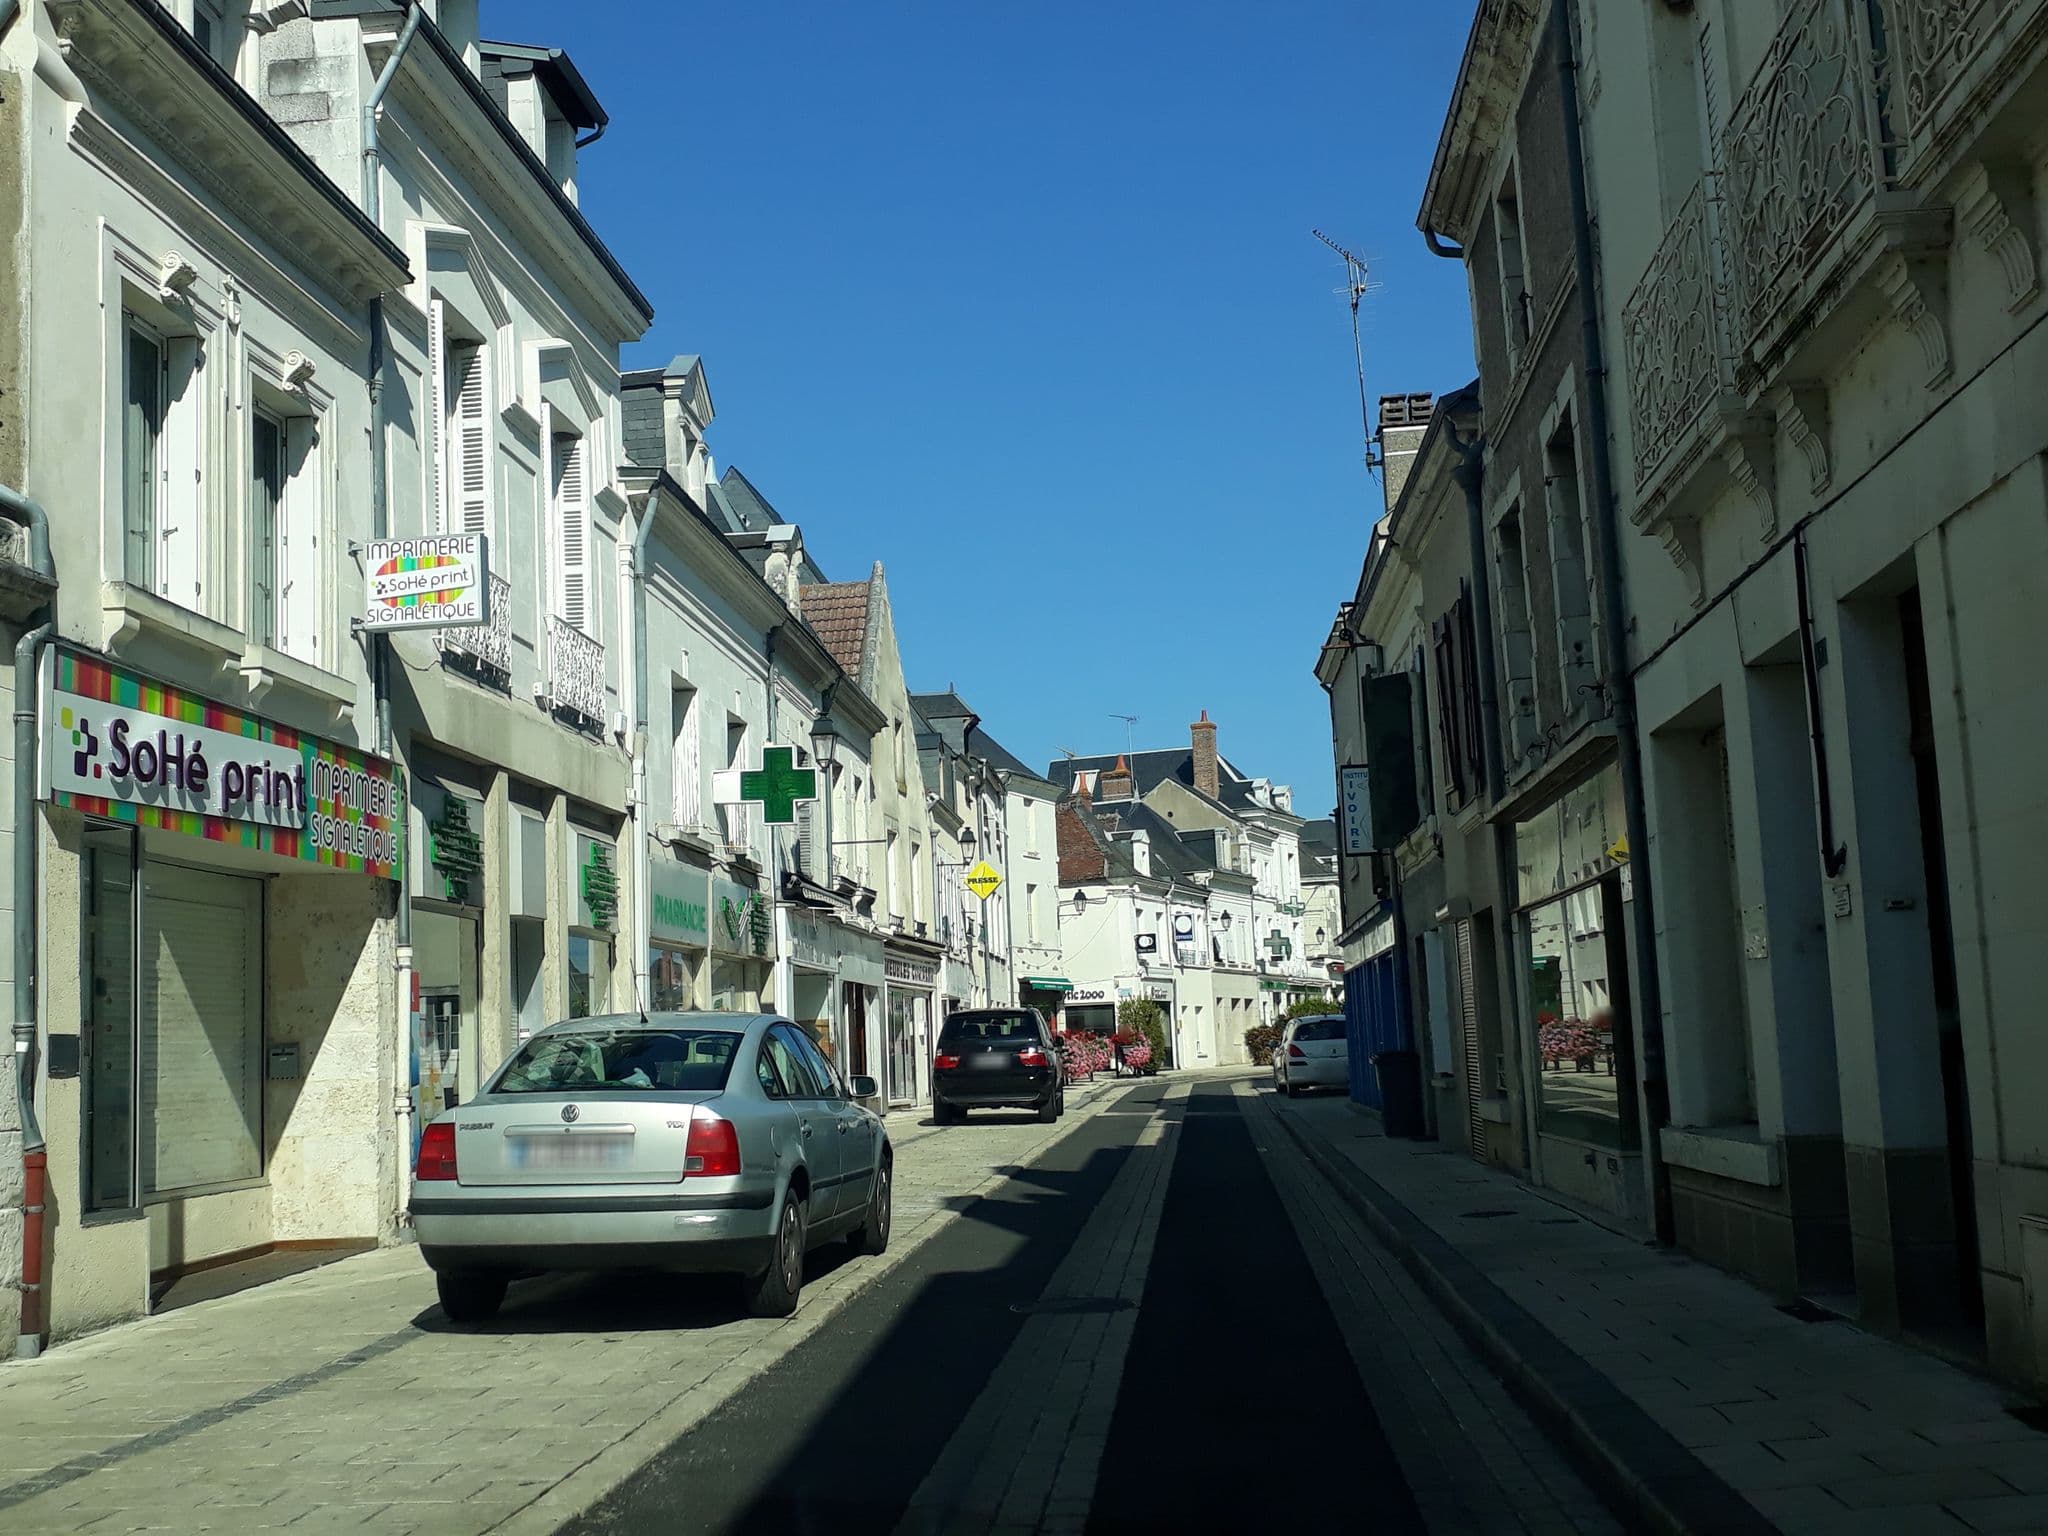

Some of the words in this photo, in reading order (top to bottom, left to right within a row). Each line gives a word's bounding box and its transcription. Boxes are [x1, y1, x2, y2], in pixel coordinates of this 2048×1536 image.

[366, 537, 475, 561] IMPRIMERIE
[389, 574, 428, 592] SoHé
[431, 568, 469, 589] print
[367, 602, 475, 623] SIGNALÉTIQUE
[108, 718, 209, 793] SoHé
[221, 759, 307, 813] print
[1343, 771, 1368, 779] INSTITU
[310, 757, 398, 821] IMPRIMERIE
[1347, 780, 1361, 849] IVOIRE
[310, 814, 398, 866] SIGNALÉTIQUE
[967, 876, 999, 884] PRESSE
[1080, 989, 1105, 1000] 2000
[458, 1122, 495, 1132] PASSAT
